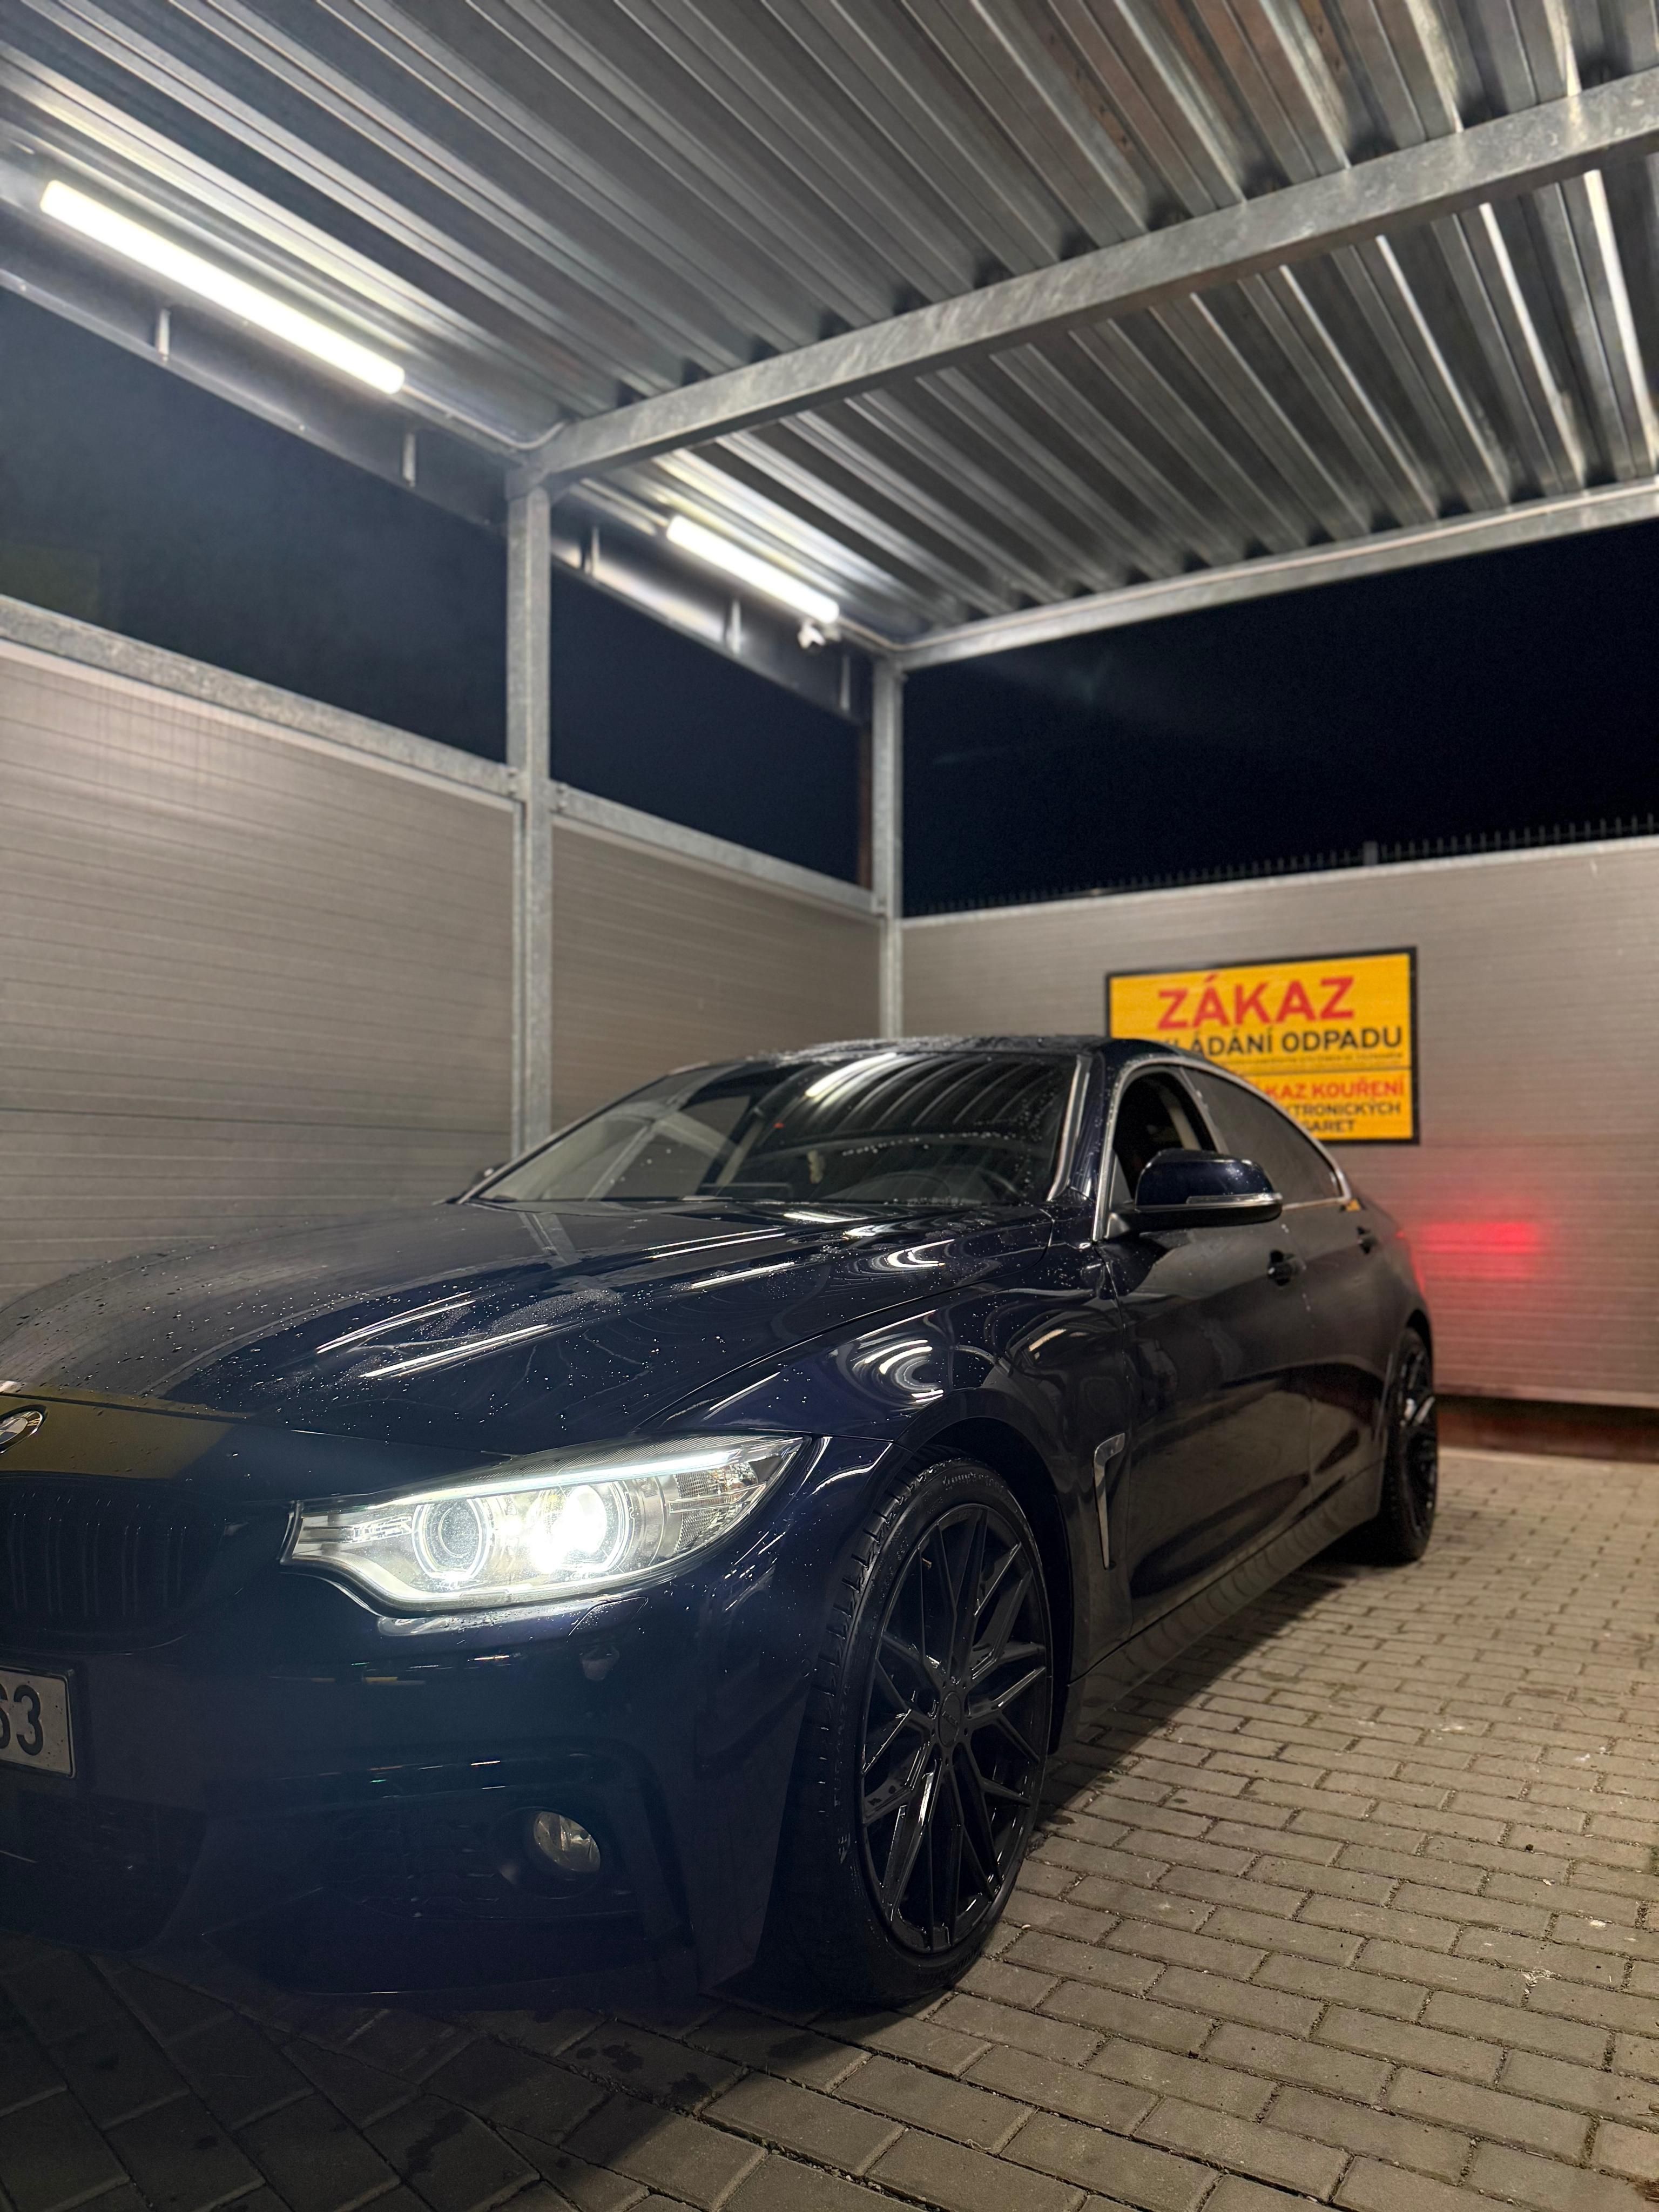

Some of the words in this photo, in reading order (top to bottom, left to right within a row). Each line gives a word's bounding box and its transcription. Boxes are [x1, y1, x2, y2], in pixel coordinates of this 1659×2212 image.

[1158, 974, 1354, 1030] ZÁKAZ
[1281, 1027, 1402, 1053] ODPADU
[1312, 1075, 1404, 1097] KOUŘENÍ
